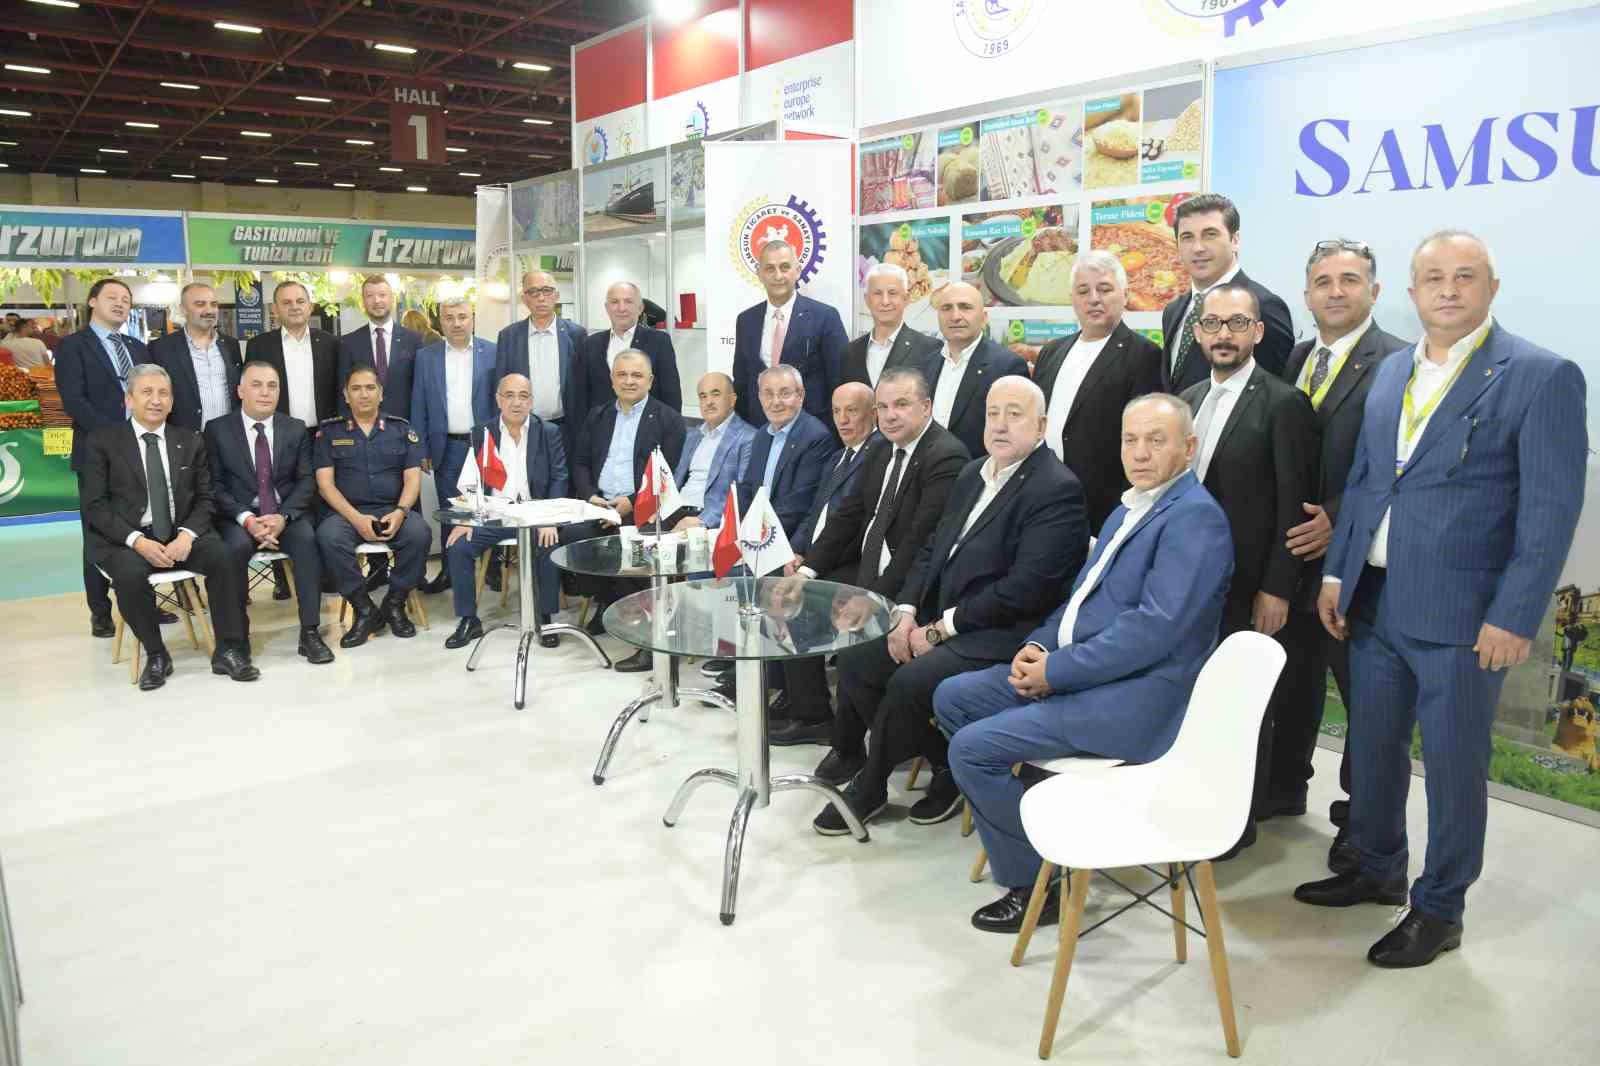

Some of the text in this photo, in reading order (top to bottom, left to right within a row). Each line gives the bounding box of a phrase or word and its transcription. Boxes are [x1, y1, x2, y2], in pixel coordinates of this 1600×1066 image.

[983, 39, 1009, 55] 1969
[784, 75, 823, 95] enterprise
[394, 87, 441, 106] HALL
[784, 94, 811, 109] europe
[784, 104, 816, 120] network
[407, 114, 429, 160] 1
[0, 224, 143, 257] rzurum
[233, 224, 341, 244] GASTRONOMİ VE
[243, 243, 335, 263] TURİZM KENTİ
[720, 335, 735, 345] TİC
